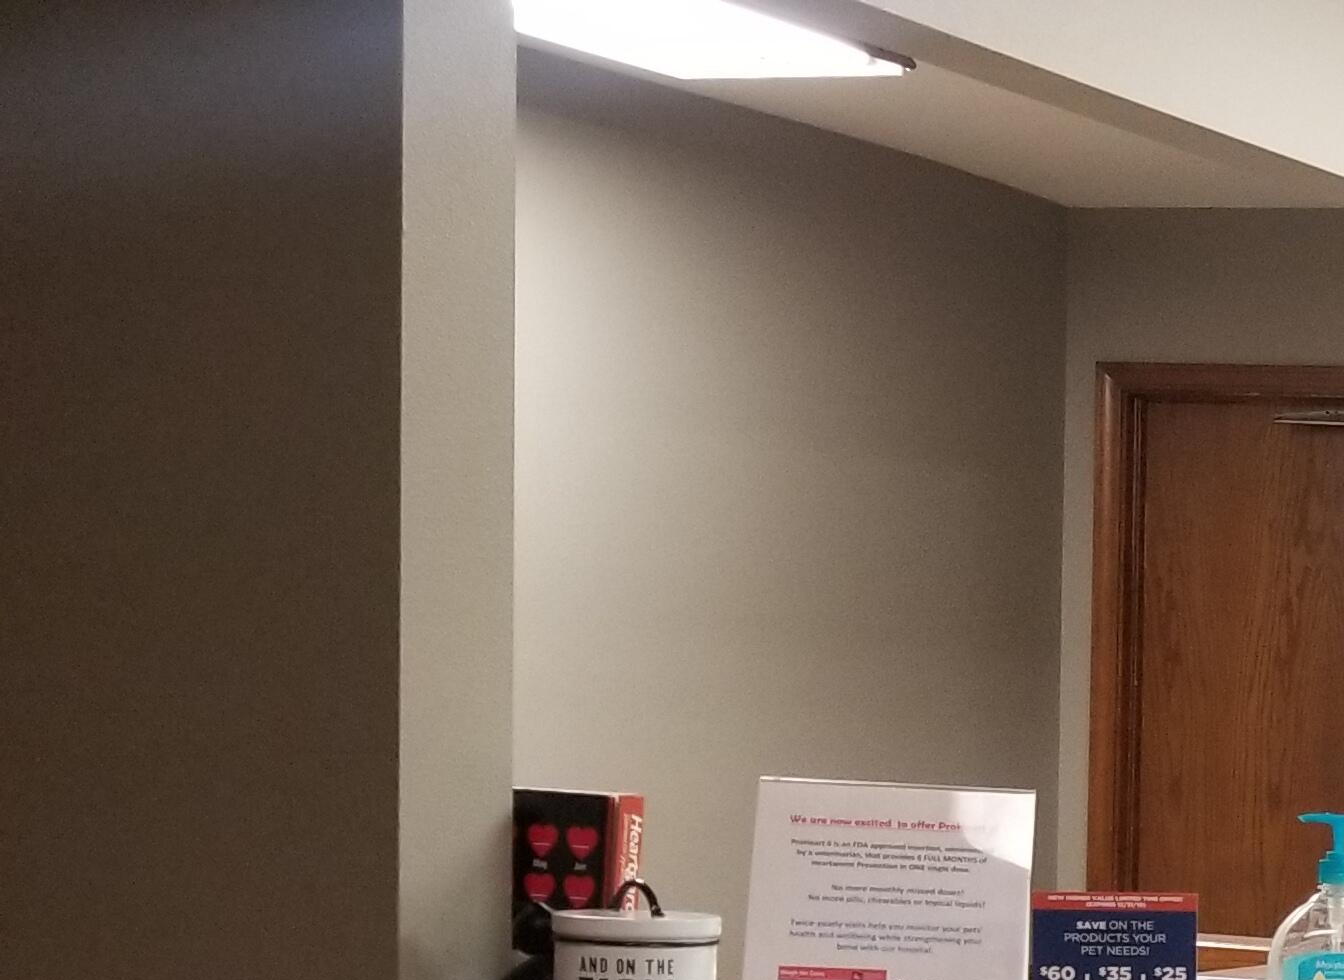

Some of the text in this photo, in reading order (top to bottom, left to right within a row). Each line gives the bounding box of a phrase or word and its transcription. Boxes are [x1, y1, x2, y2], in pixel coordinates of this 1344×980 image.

[1075, 920, 1155, 931] SAVE ON THE
[1064, 932, 1167, 944] PRODUCTS YOUR
[1080, 945, 1151, 956] PET NEEDS!
[579, 957, 675, 975] AND ON THE
